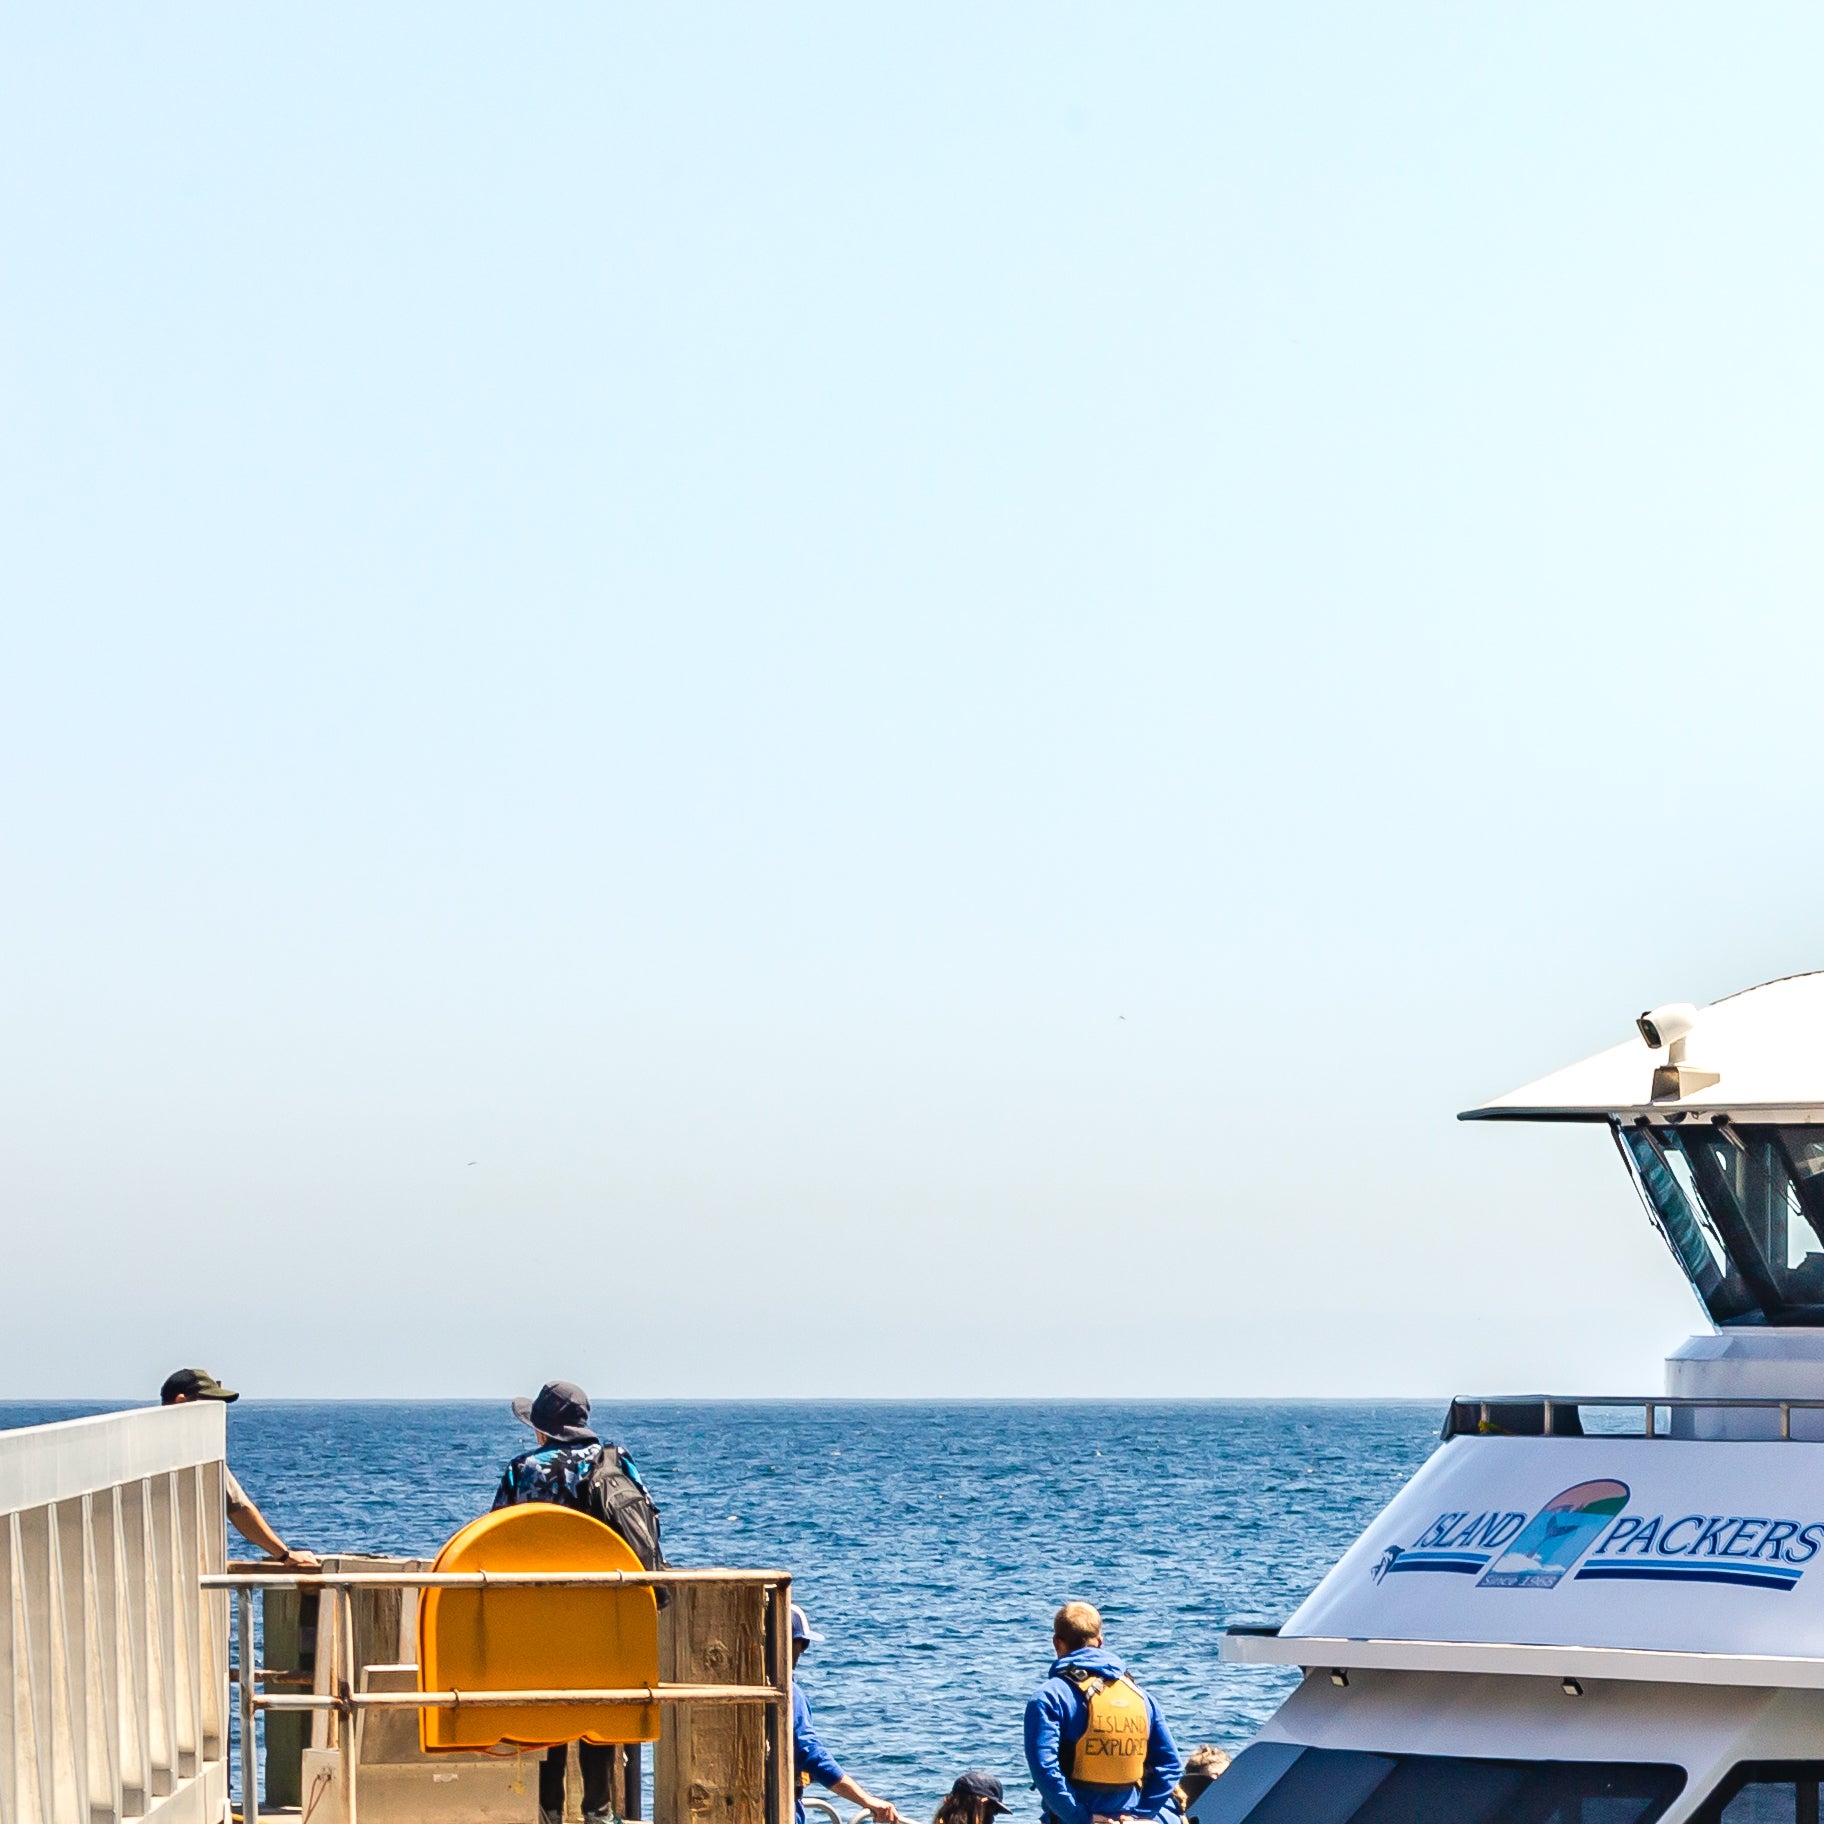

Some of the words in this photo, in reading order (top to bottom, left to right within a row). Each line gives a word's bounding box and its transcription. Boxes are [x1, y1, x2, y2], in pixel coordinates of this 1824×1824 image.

[1411, 1510, 1528, 1549] ISLAND
[1093, 1715, 1146, 1733] ISLAND
[1085, 1738, 1148, 1756] EXPLORE
